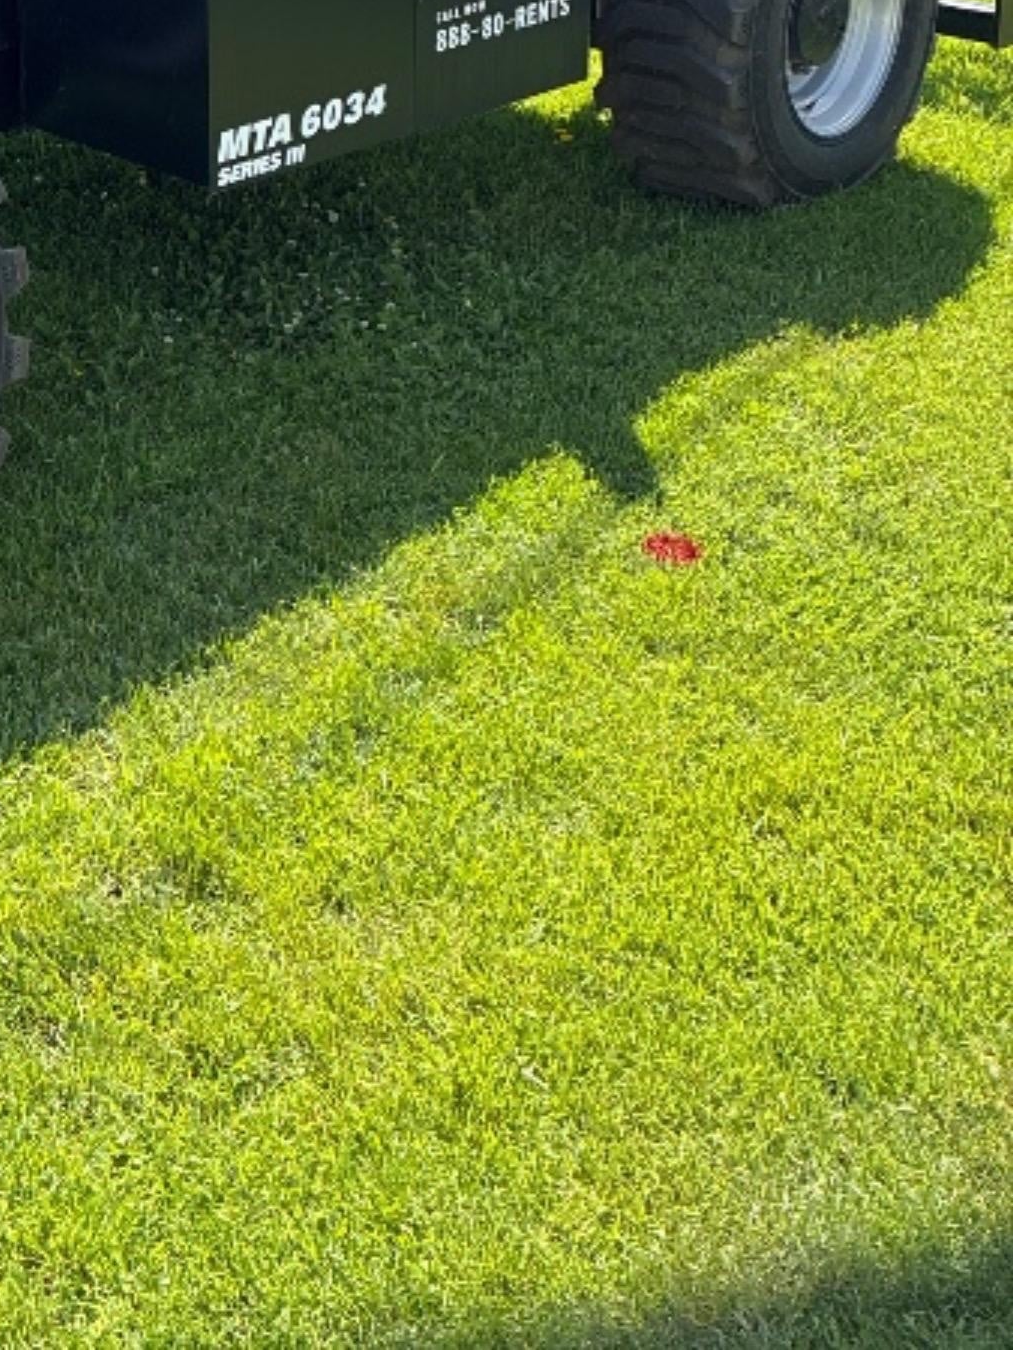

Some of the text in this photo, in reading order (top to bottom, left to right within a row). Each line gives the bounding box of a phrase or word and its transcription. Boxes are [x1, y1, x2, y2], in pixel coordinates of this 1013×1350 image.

[217, 83, 387, 164] MTA 6034
[217, 151, 282, 188] SERIES
